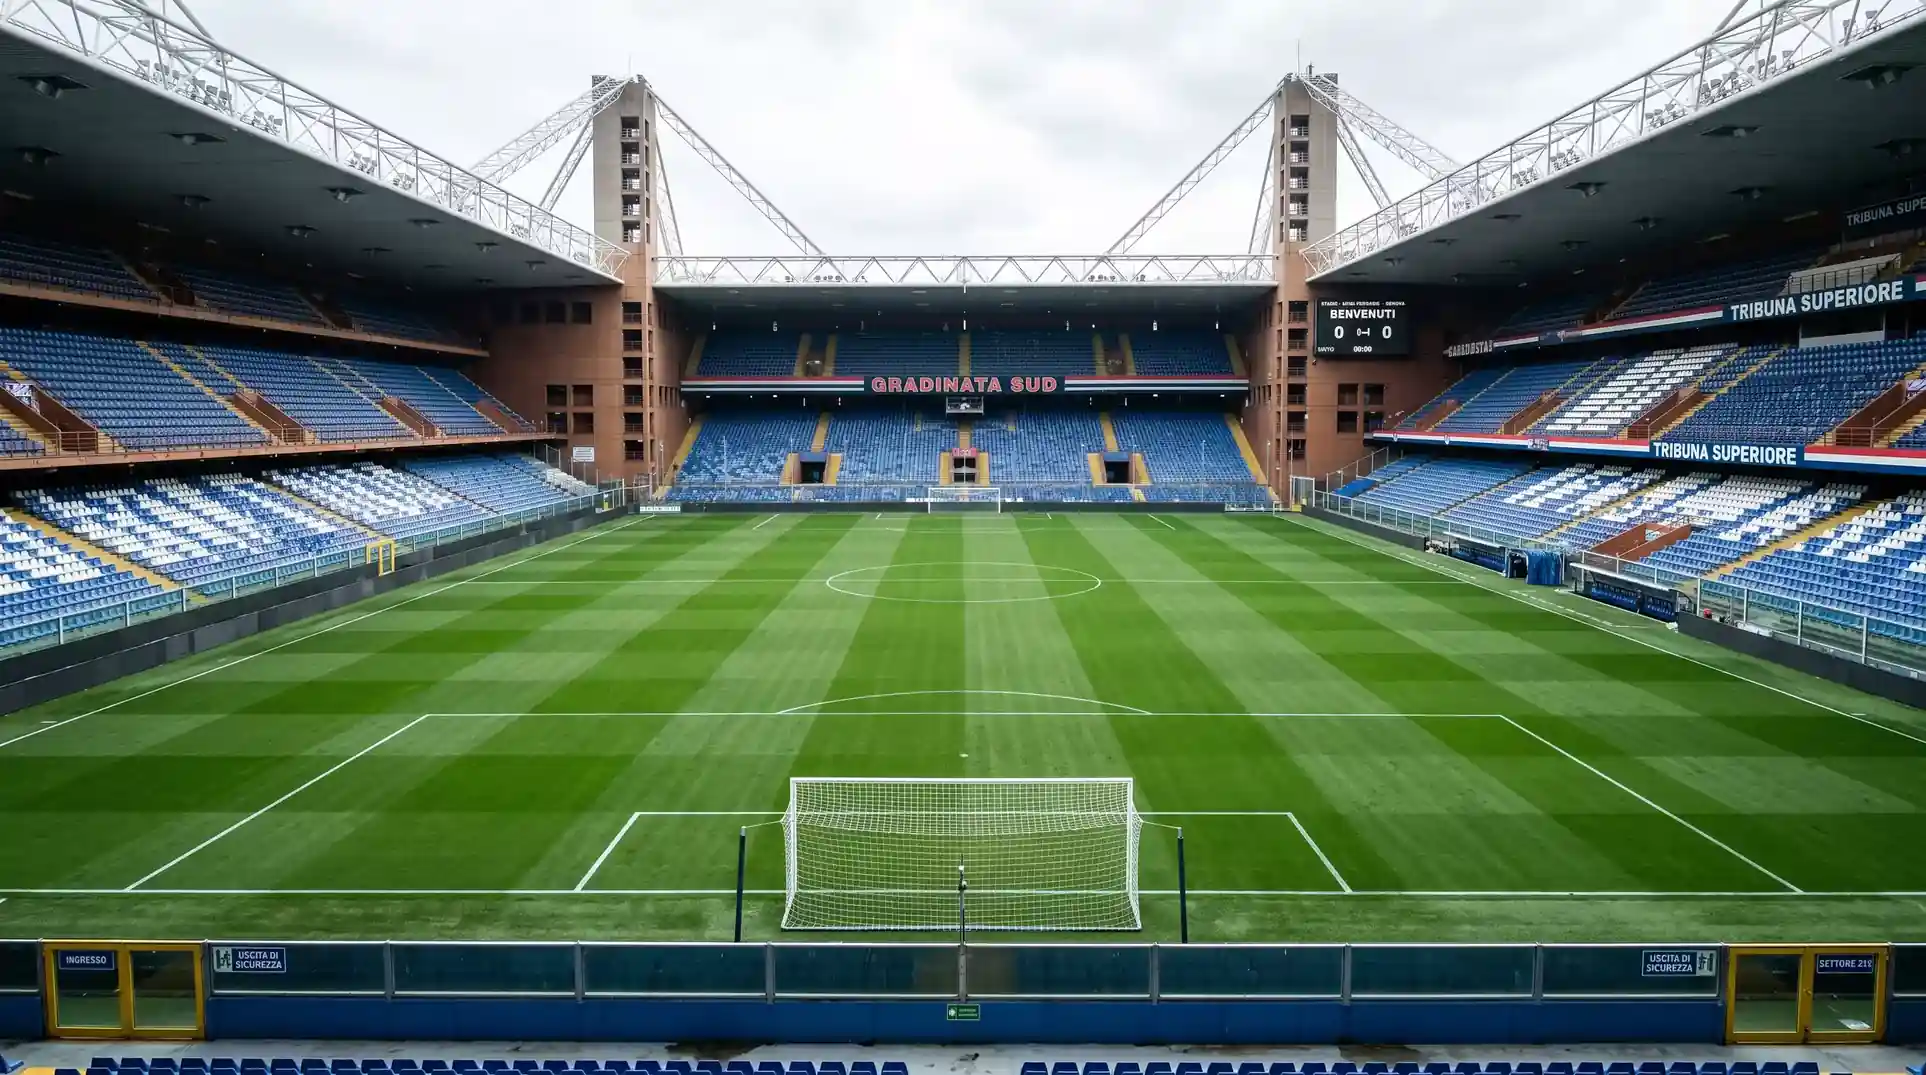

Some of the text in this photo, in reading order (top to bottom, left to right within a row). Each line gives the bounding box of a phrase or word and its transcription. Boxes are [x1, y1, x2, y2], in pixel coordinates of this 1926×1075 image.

[1846, 205, 1894, 226] TRIBUNA
[1730, 280, 1904, 321] TRIBUNA SUPERIORE
[1330, 309, 1396, 319] BENVENUTI
[1334, 325, 1344, 339] 0
[1382, 325, 1392, 339] 0
[871, 376, 1057, 393] GRADINATA SUD
[1653, 442, 1797, 465] TRIBUNA SUPERIORE
[66, 955, 107, 964] INGRESSO
[238, 951, 279, 960] USCITA DI
[1650, 954, 1691, 963] USCITA DI
[235, 960, 282, 969] SICUREZZA
[1646, 963, 1693, 972] SICUREZZA
[1819, 959, 1856, 968] SETTORE
